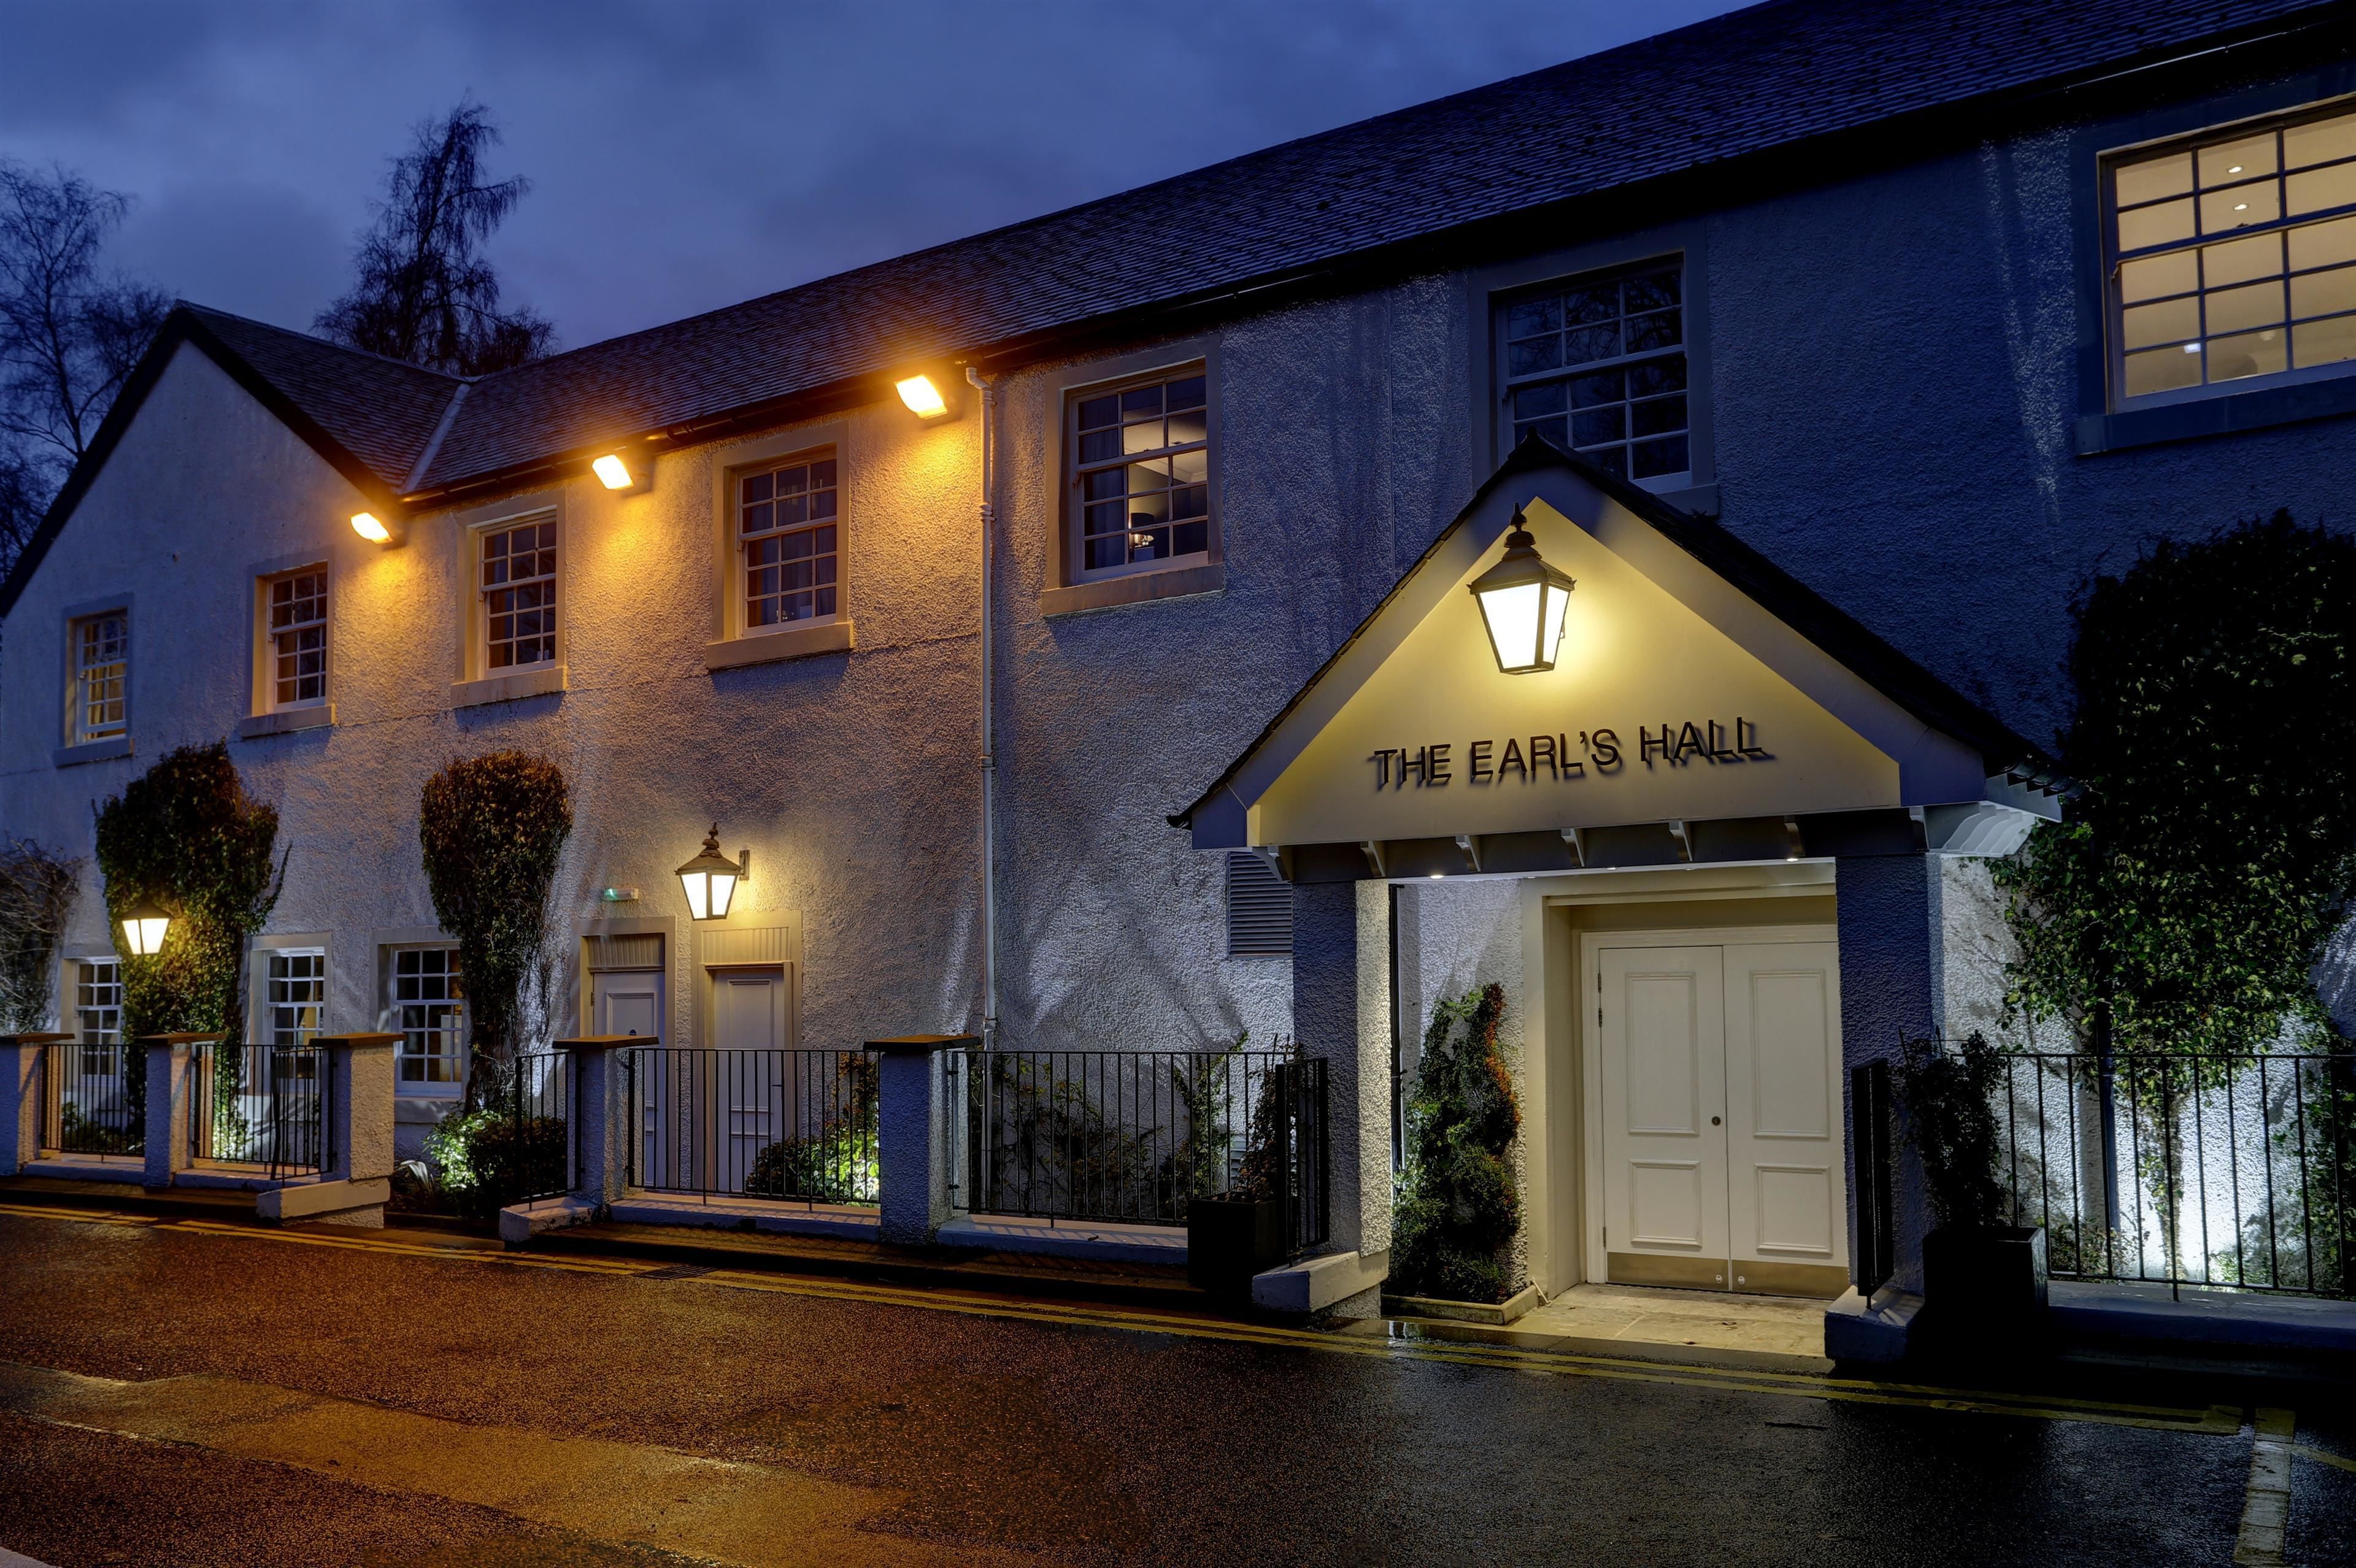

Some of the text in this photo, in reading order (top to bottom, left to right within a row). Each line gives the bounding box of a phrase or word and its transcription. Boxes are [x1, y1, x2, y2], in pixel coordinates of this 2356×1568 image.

[1374, 717, 1763, 784] THE EARL'S HALL
